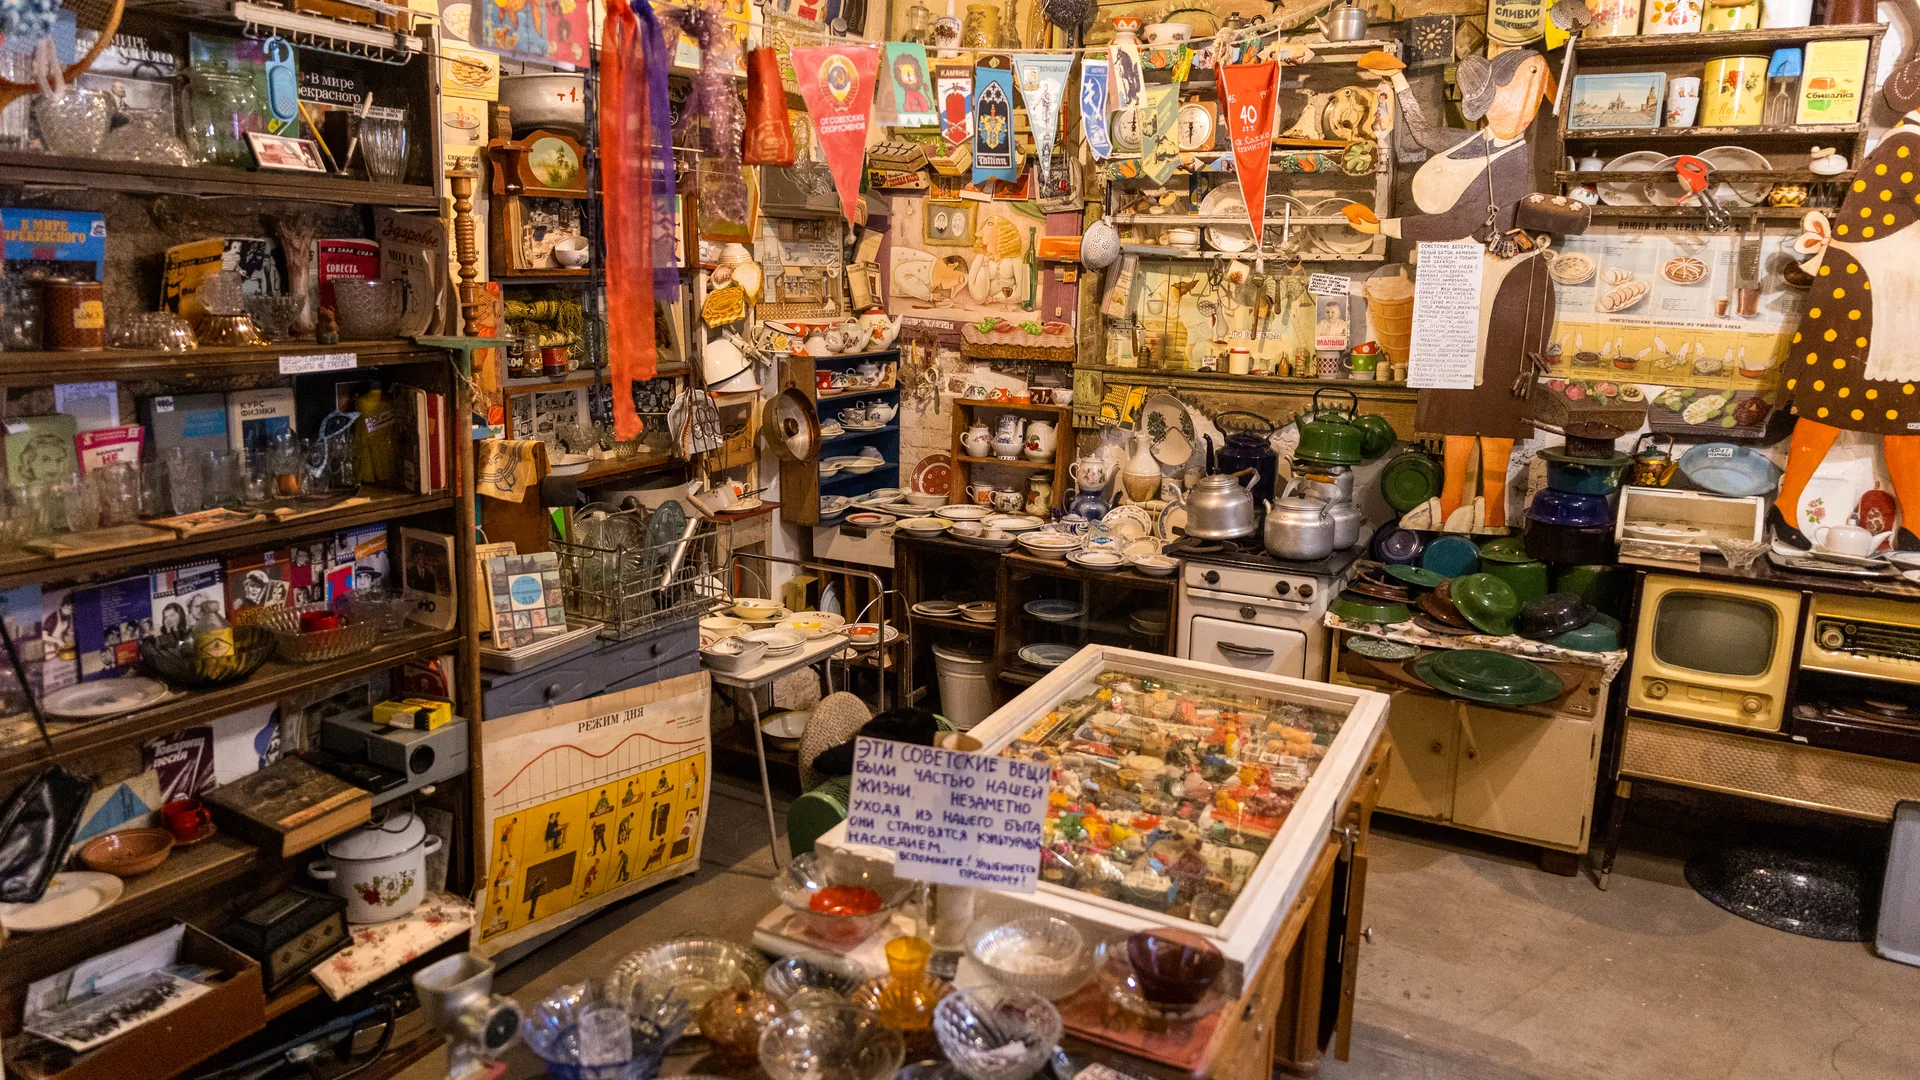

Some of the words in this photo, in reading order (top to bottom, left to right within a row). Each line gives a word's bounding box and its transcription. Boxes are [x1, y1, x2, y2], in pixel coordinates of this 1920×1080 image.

[1495, 7, 1540, 19] СЛИВКИ
[941, 69, 969, 77] КАМЯНЕЦ
[321, 76, 354, 91] мире
[298, 86, 361, 103] екрасного
[829, 114, 865, 125] СОВЕТСКИХ
[1240, 105, 1258, 125] 40
[820, 123, 866, 134] СПОРТСМЕНОВ
[978, 156, 1008, 166] Tallinn
[382, 216, 440, 248] Здоровье
[1617, 221, 1650, 231] БЛЮДА
[1655, 222, 1668, 231] ИЗ
[326, 264, 358, 273] СОВЕСТЬ
[240, 407, 276, 417] ФИЗИКИ
[578, 715, 619, 733] РЕЖИМ
[623, 706, 644, 724] ДНЯ
[857, 738, 893, 759] ЭТИ
[901, 744, 998, 773] СОВЕТСКИЕ
[1009, 761, 1051, 783] ВЕЩИ
[856, 760, 897, 777] БЫЛИ
[913, 768, 975, 789] ЧАСТЬЮ
[986, 778, 1044, 800] НАШЕЙ
[950, 792, 1032, 815] НЕЗАМЕТНО
[853, 799, 901, 817] УХОДЯ
[915, 808, 933, 821] ИЗ
[943, 810, 994, 828] НАШЕГО
[1004, 819, 1042, 835] БЫТА
[849, 815, 875, 829] ОНИ
[887, 819, 968, 841] СТАНОВЯТСЯ
[975, 857, 1037, 874] УЛЫБНИТЕСЬ
